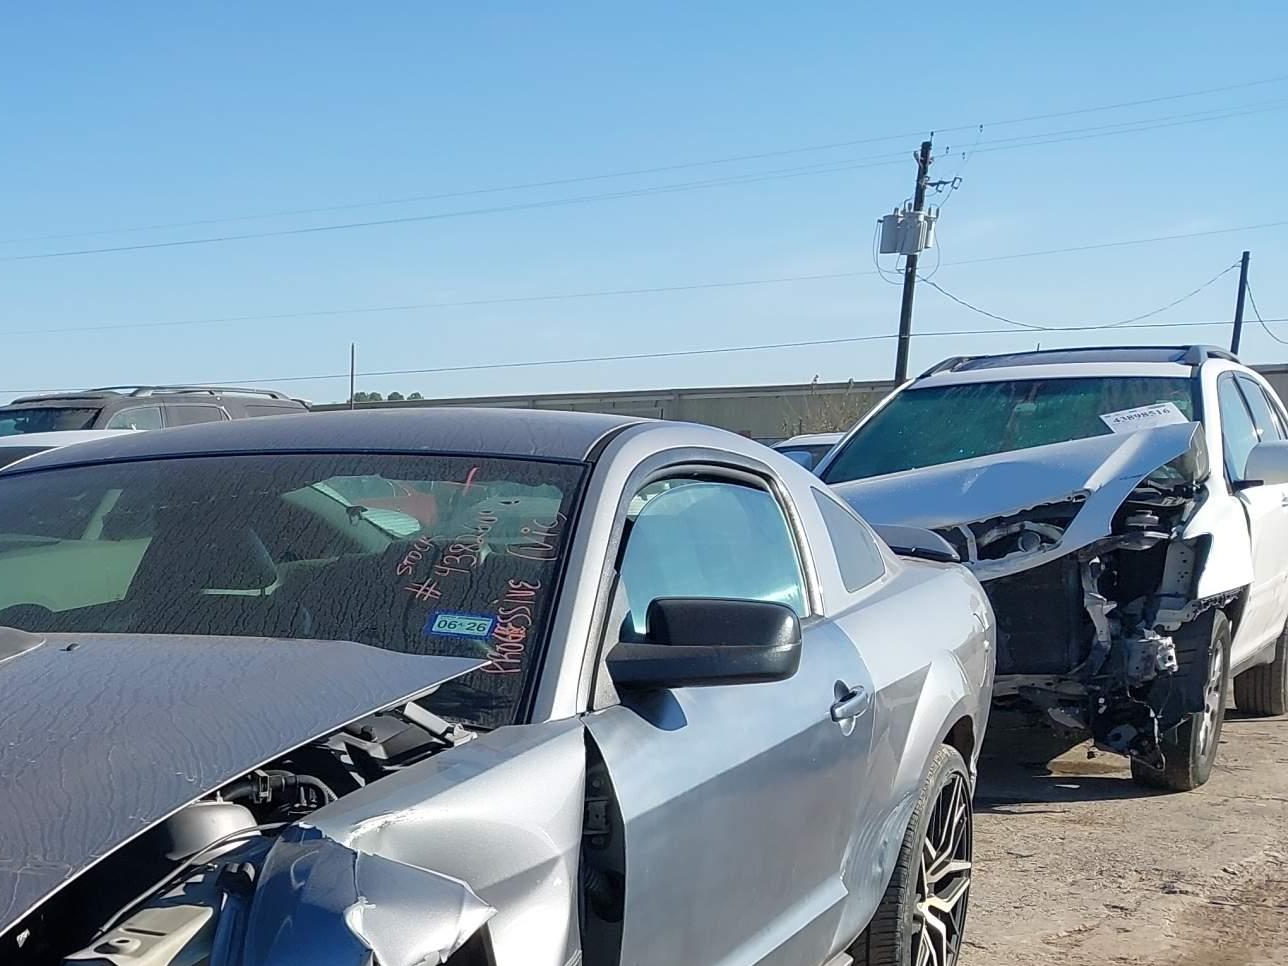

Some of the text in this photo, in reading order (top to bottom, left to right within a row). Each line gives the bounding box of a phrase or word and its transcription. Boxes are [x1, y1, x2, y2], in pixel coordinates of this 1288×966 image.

[404, 577, 442, 601] #
[437, 619, 487, 632] 06 26
